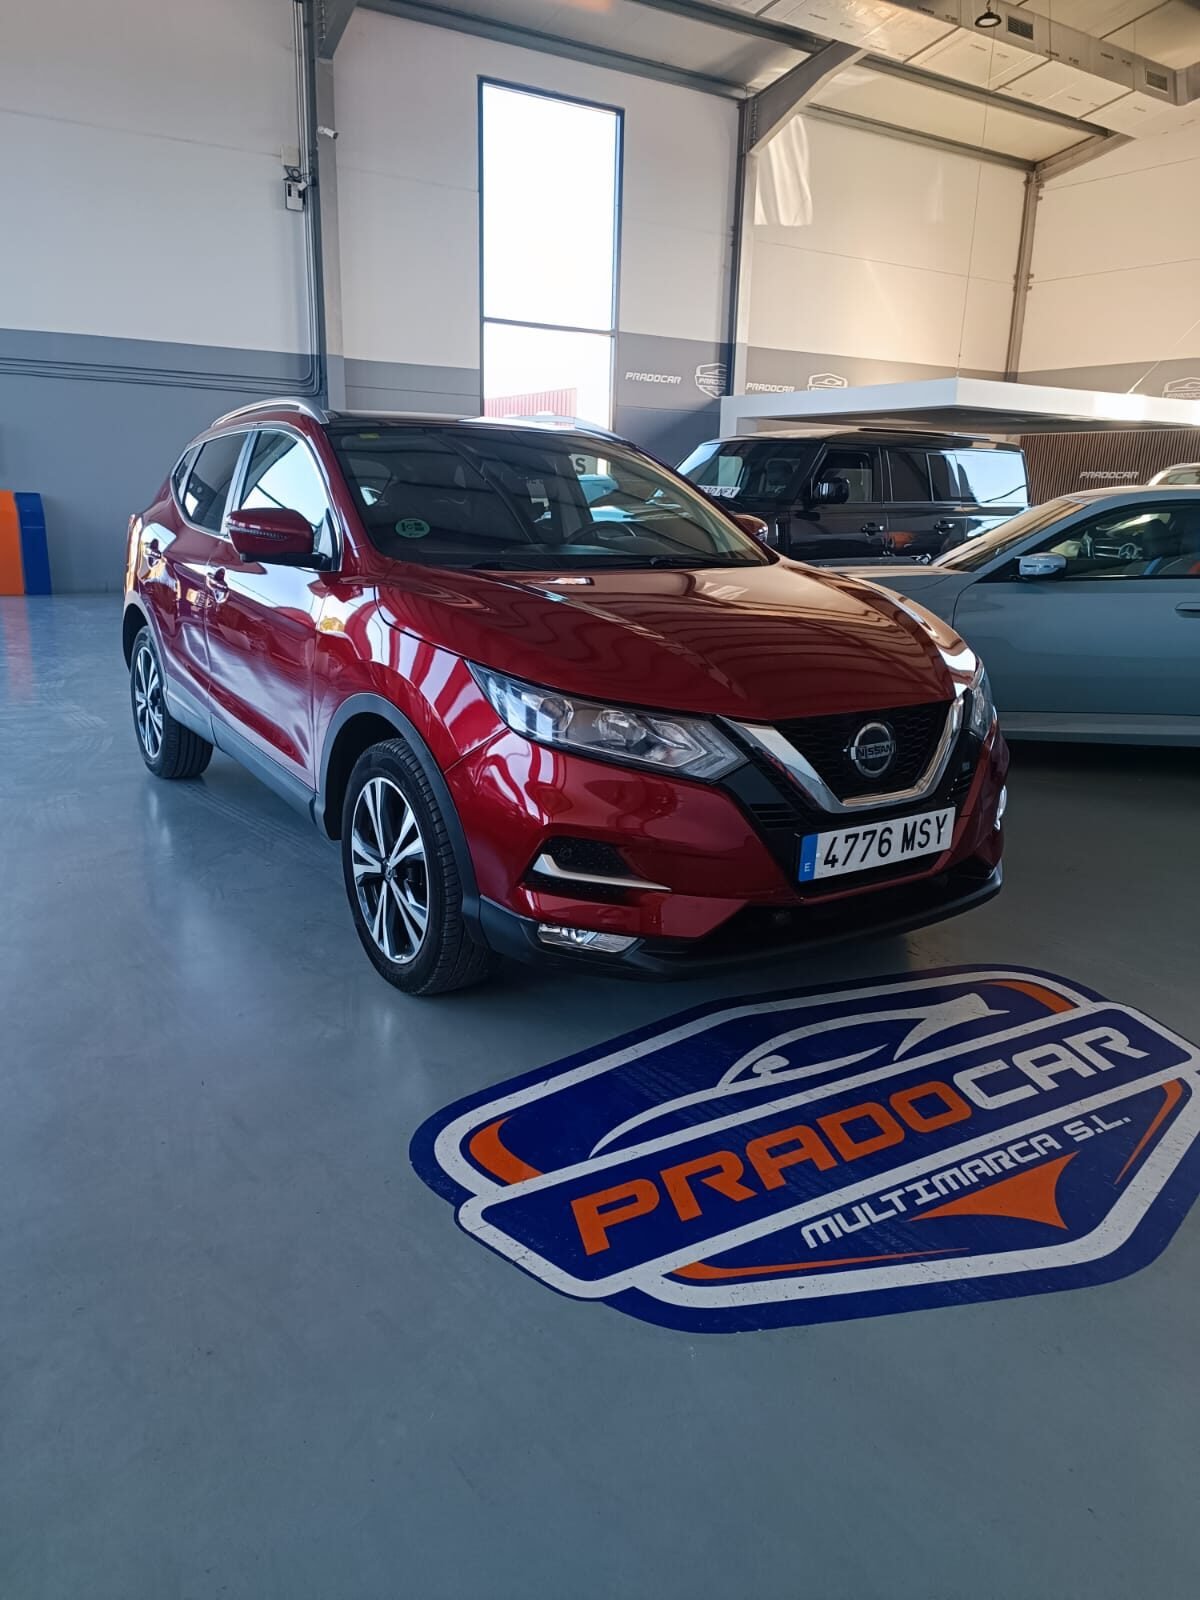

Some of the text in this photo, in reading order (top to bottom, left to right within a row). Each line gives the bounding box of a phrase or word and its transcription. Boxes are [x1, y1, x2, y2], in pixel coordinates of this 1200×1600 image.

[624, 371, 682, 385] PRADOCAR
[1079, 471, 1140, 480] PRADOCAR
[856, 743, 892, 759] NISSAN
[823, 813, 948, 869] 4776 MSY
[571, 1026, 1150, 1256] PRADOCAR
[800, 1114, 1132, 1248] MULTIMARCA S.L.
